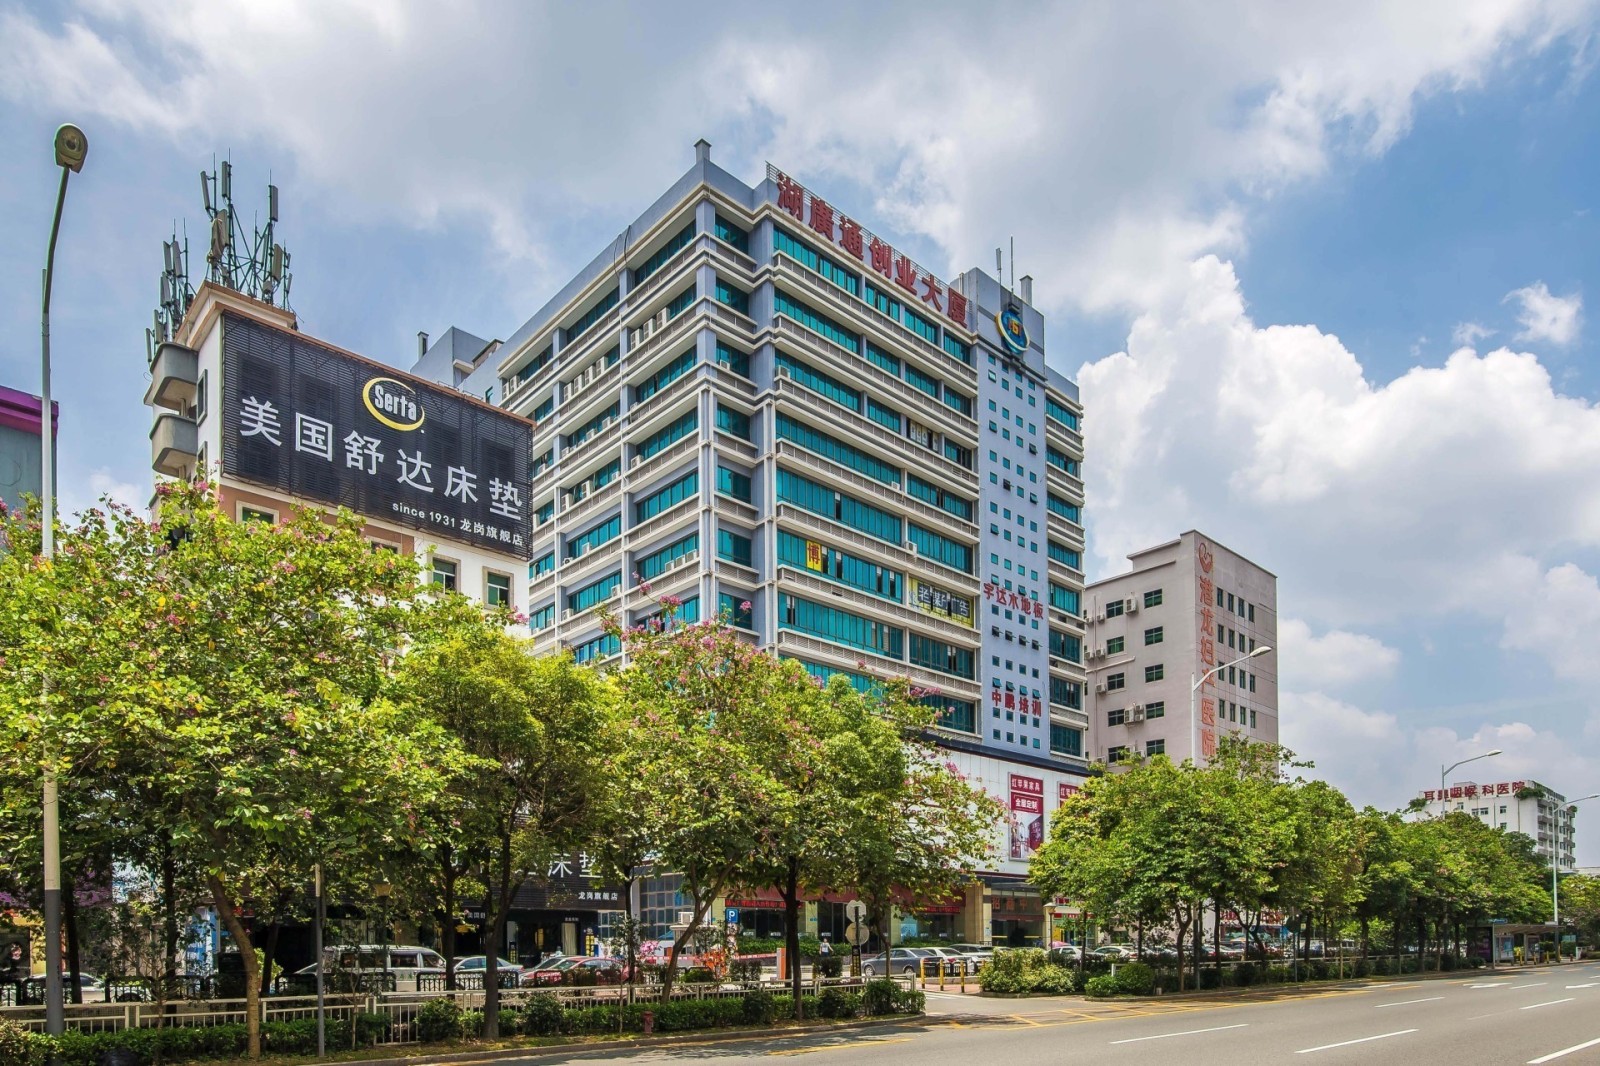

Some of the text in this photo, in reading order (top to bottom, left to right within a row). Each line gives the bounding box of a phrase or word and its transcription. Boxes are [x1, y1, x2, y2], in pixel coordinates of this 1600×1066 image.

[374, 384, 417, 421] Serta
[240, 396, 522, 521] 美国舒达床垫
[392, 502, 456, 528] since 1931
[459, 518, 523, 547] 龙岗旗舰店
[1011, 778, 1040, 792] 红苹果家具
[1423, 781, 1525, 801] 耳鼻咽喉科医院
[578, 891, 618, 900] 龙岗旗舰店
